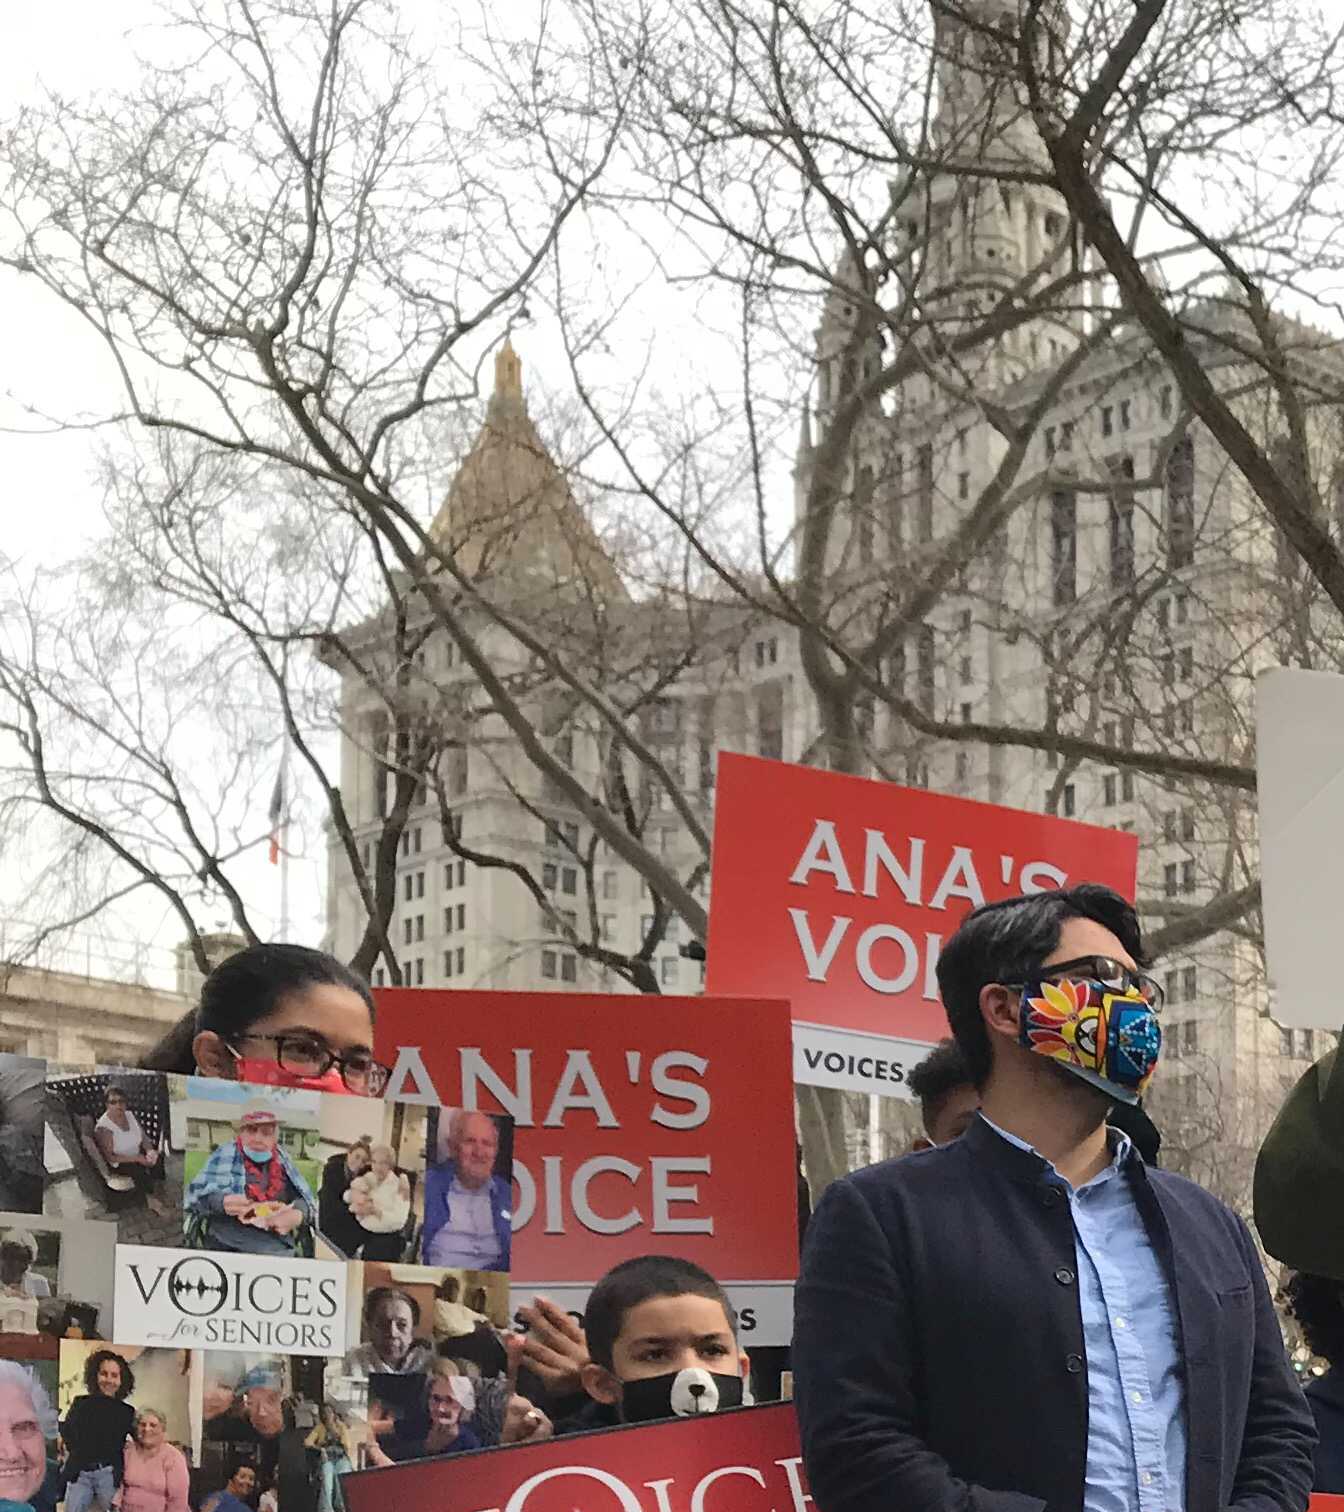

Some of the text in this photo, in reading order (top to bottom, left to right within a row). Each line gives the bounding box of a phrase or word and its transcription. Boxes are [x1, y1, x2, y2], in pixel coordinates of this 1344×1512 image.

[383, 1046, 712, 1130] ANA'S
[803, 1048, 904, 1083] VOICES
[126, 1256, 338, 1318] VOICES
[205, 1317, 332, 1349] SENIORS
